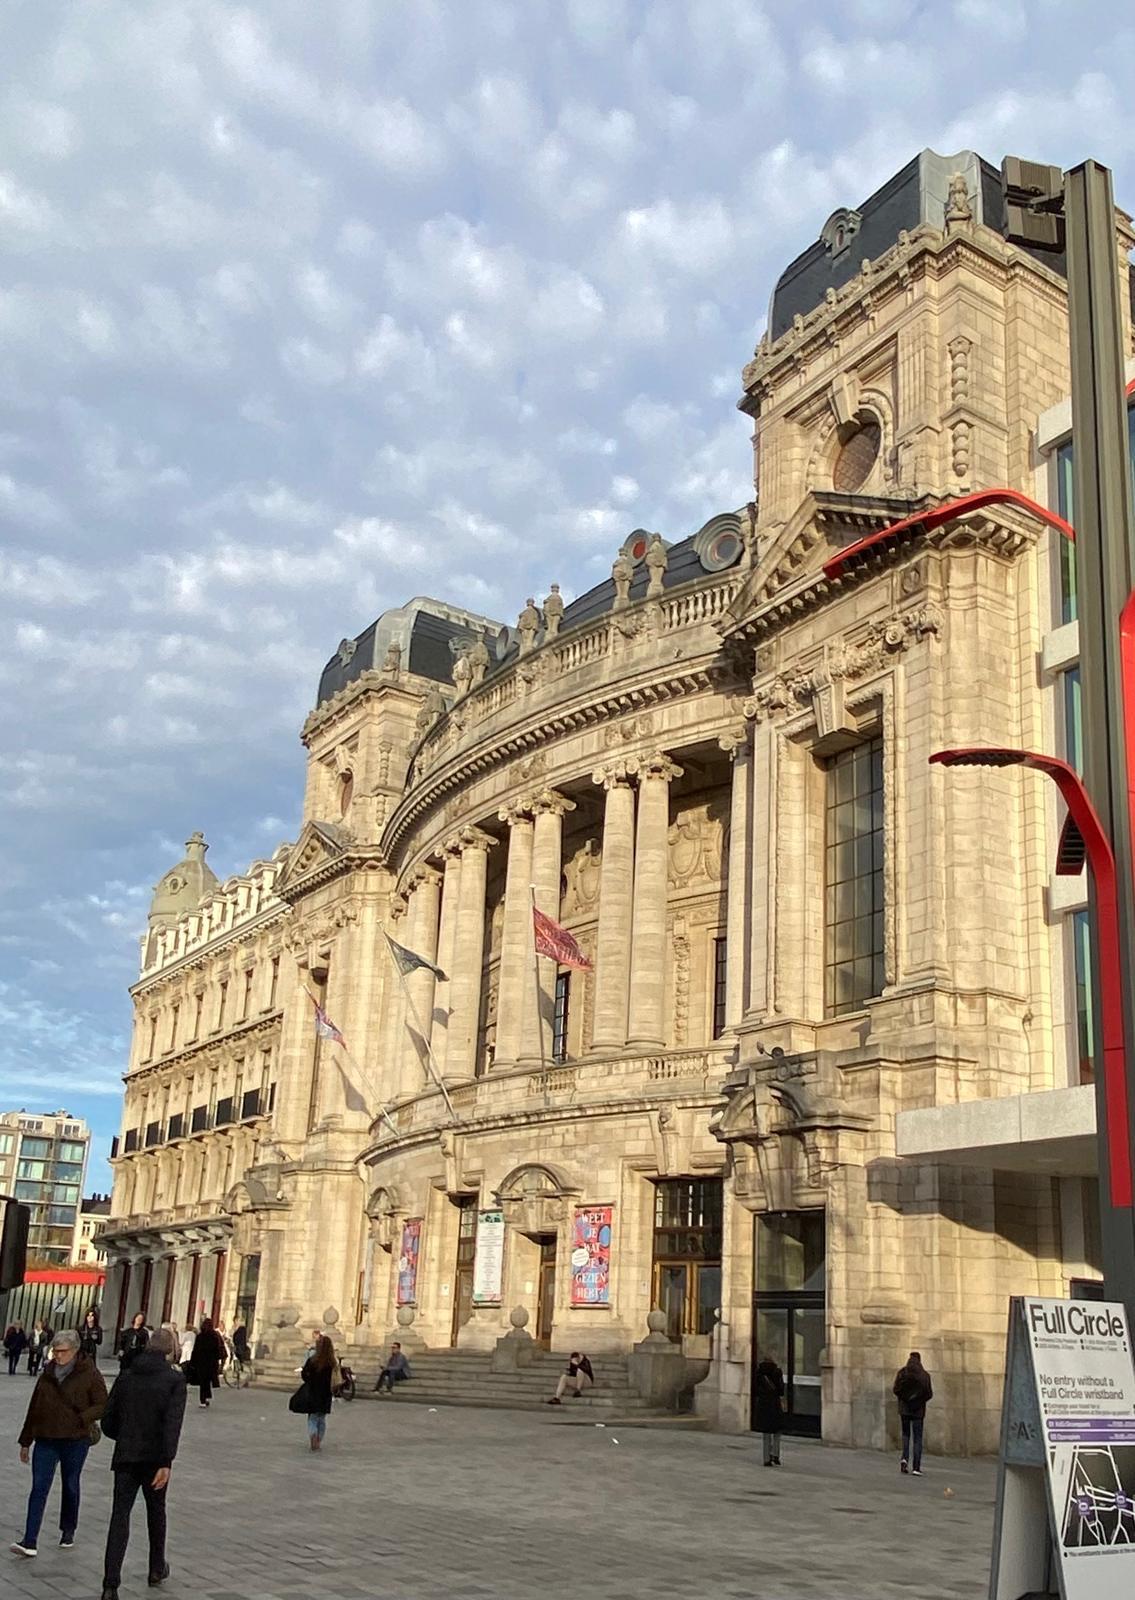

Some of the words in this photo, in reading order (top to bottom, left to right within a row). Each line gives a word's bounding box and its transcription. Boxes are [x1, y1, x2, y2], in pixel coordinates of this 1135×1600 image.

[581, 1213, 605, 1223] WEET
[587, 1228, 597, 1238] JE
[583, 1243, 600, 1253] WAT
[576, 1272, 606, 1284] GEZIEN
[1029, 1304, 1067, 1334] Full
[1067, 1306, 1124, 1337] Circle
[1039, 1374, 1053, 1385] No
[1054, 1376, 1076, 1388] entry
[1077, 1375, 1108, 1387] without
[1109, 1378, 1114, 1387] a
[1041, 1387, 1057, 1399] Full
[1058, 1387, 1084, 1399] Circle
[1084, 1389, 1124, 1399] wristband
